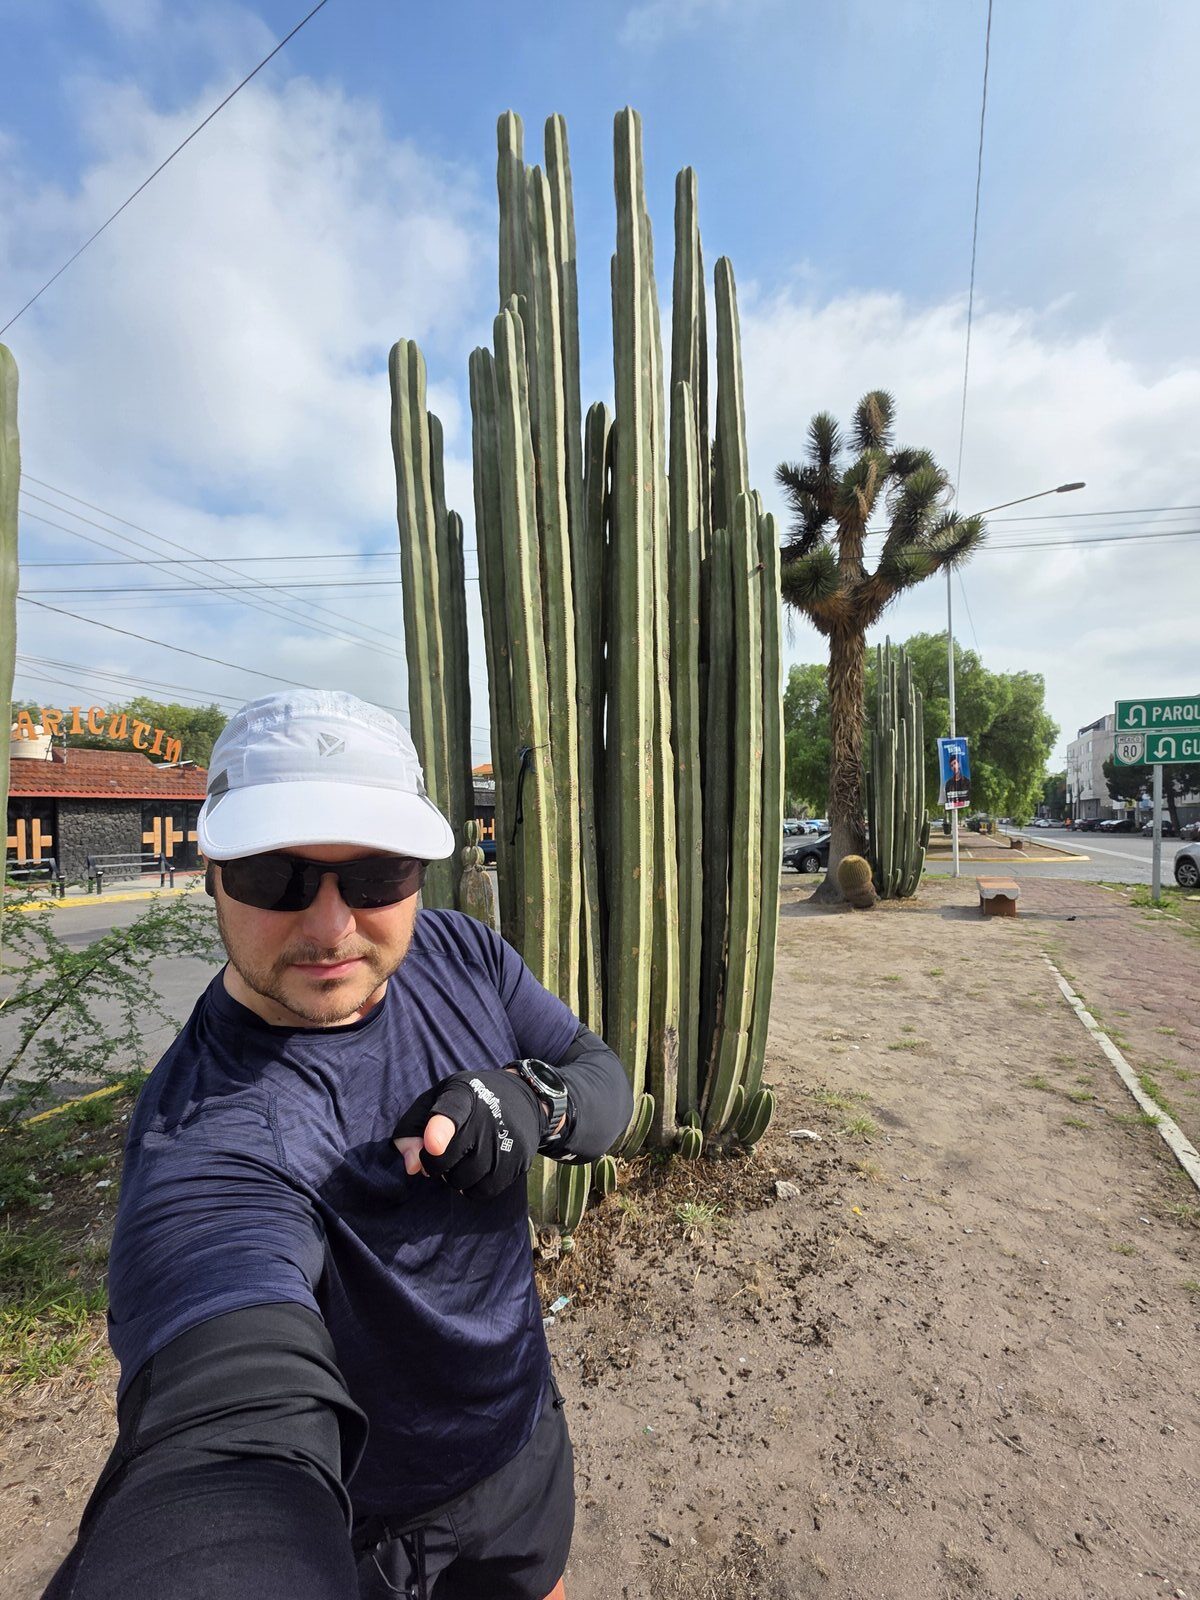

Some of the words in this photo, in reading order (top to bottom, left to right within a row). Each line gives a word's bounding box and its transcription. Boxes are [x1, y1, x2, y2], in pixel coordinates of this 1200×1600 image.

[1152, 704, 1200, 722] PARQU
[1123, 744, 1137, 758] 80
[1182, 738, 1200, 755] GU
